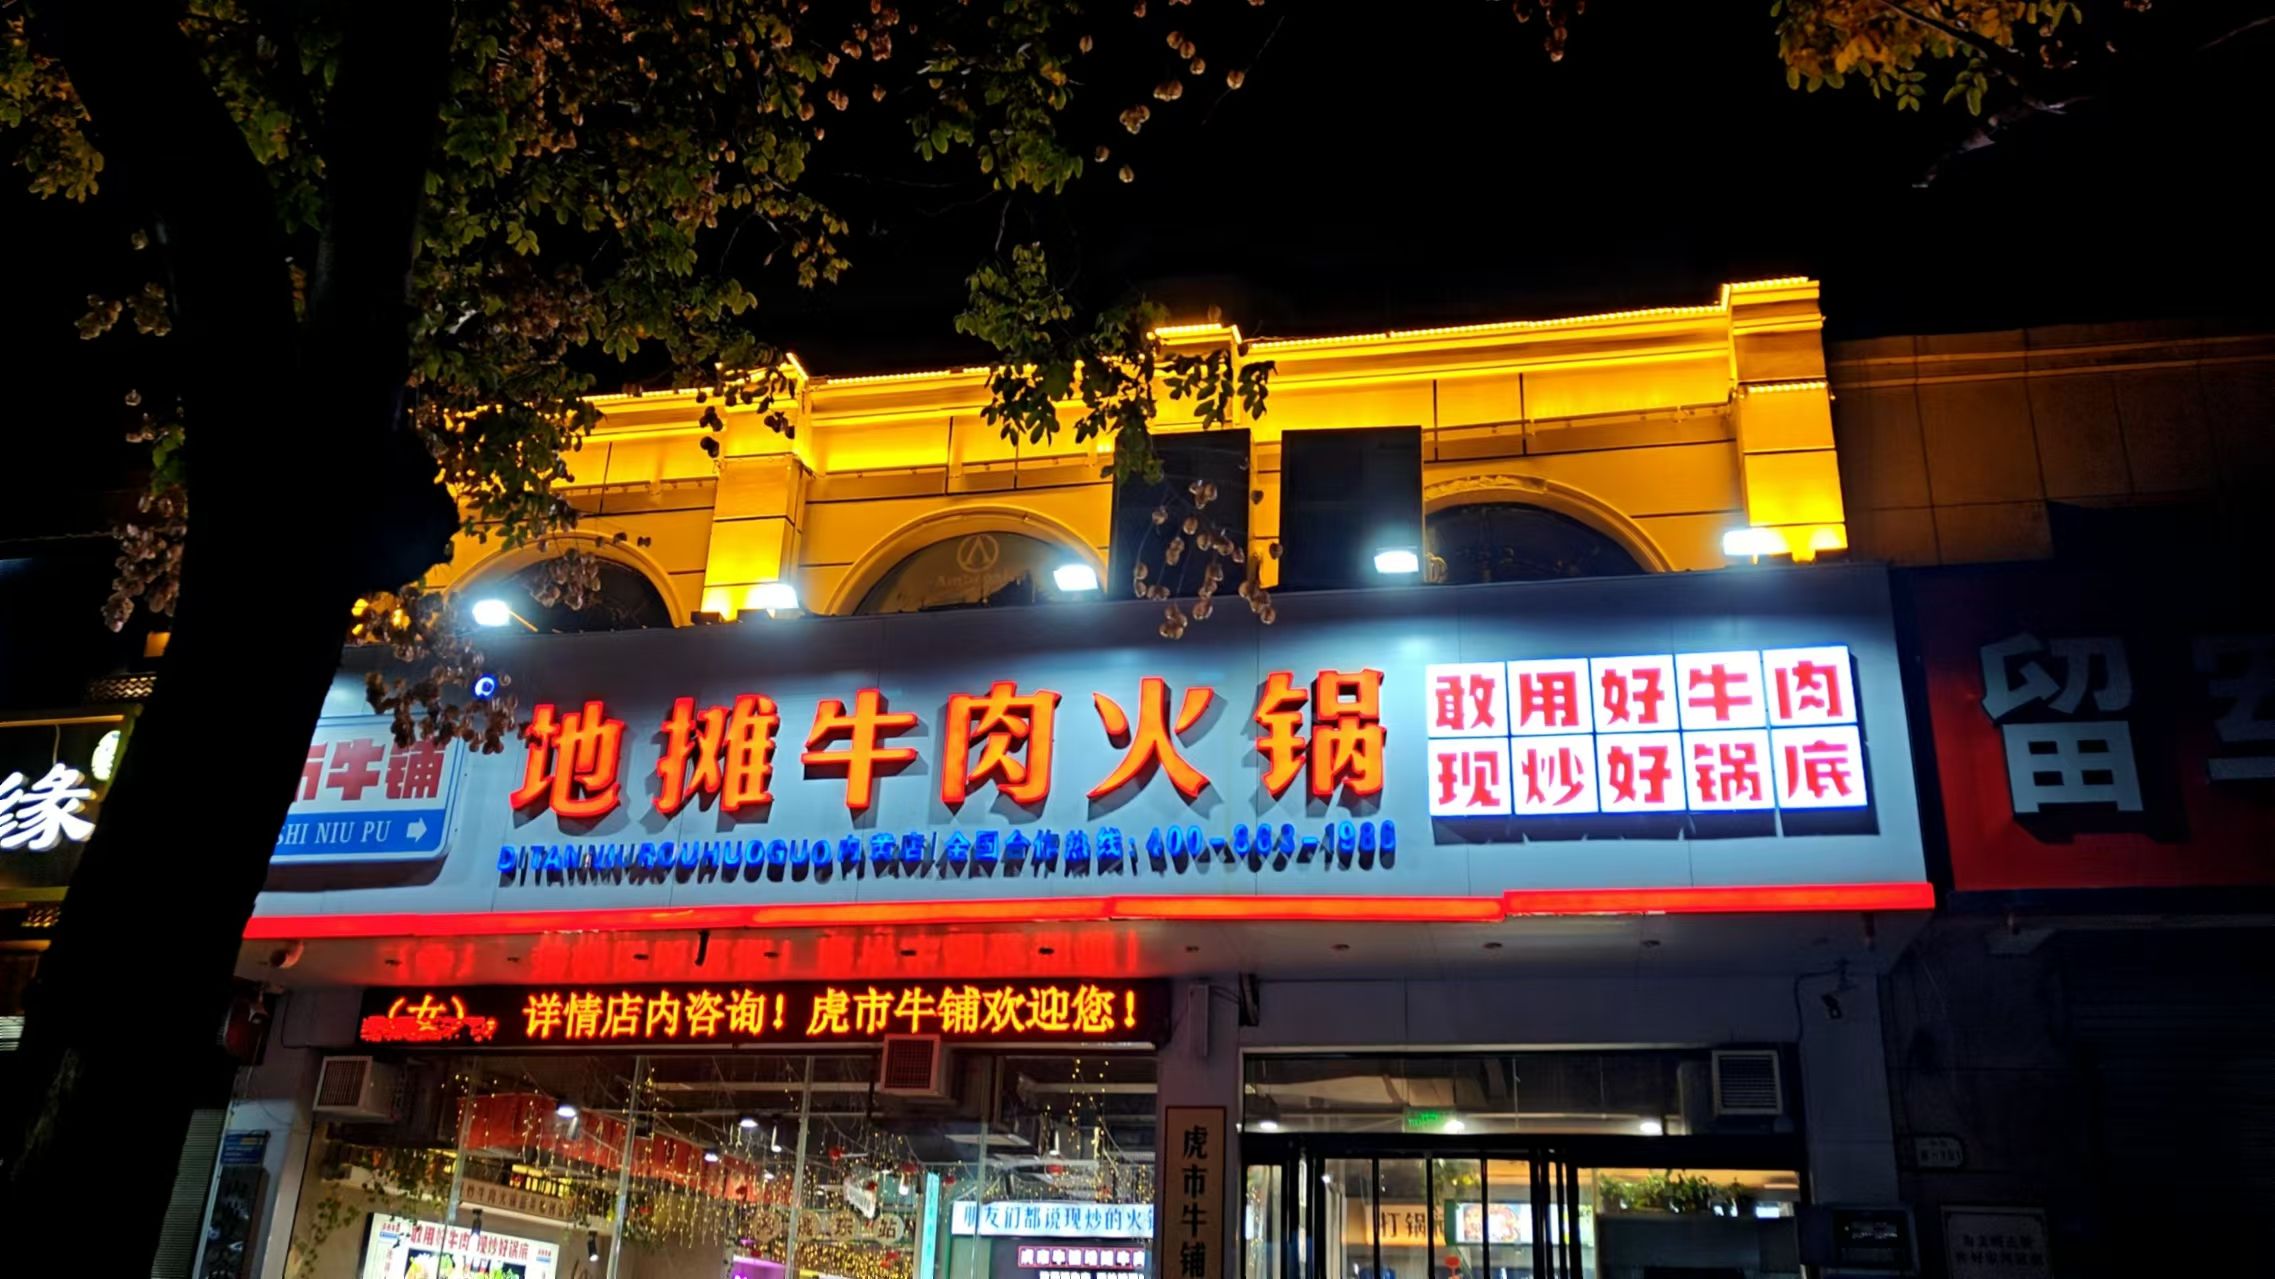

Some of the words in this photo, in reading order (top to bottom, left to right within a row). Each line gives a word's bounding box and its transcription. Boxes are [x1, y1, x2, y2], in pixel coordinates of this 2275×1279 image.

[1435, 660, 1843, 730] 敢用好牛肉
[509, 668, 1386, 818] 地摊牛肉火锅
[1437, 740, 1852, 808] 现炒好锅底
[314, 820, 356, 844] NIU
[360, 819, 392, 842] PU
[522, 989, 785, 1039] 详情店内咨询！
[806, 985, 1136, 1034] 虎市牛铺欢迎您！
[1179, 1124, 1209, 1278] 虎市牛铺
